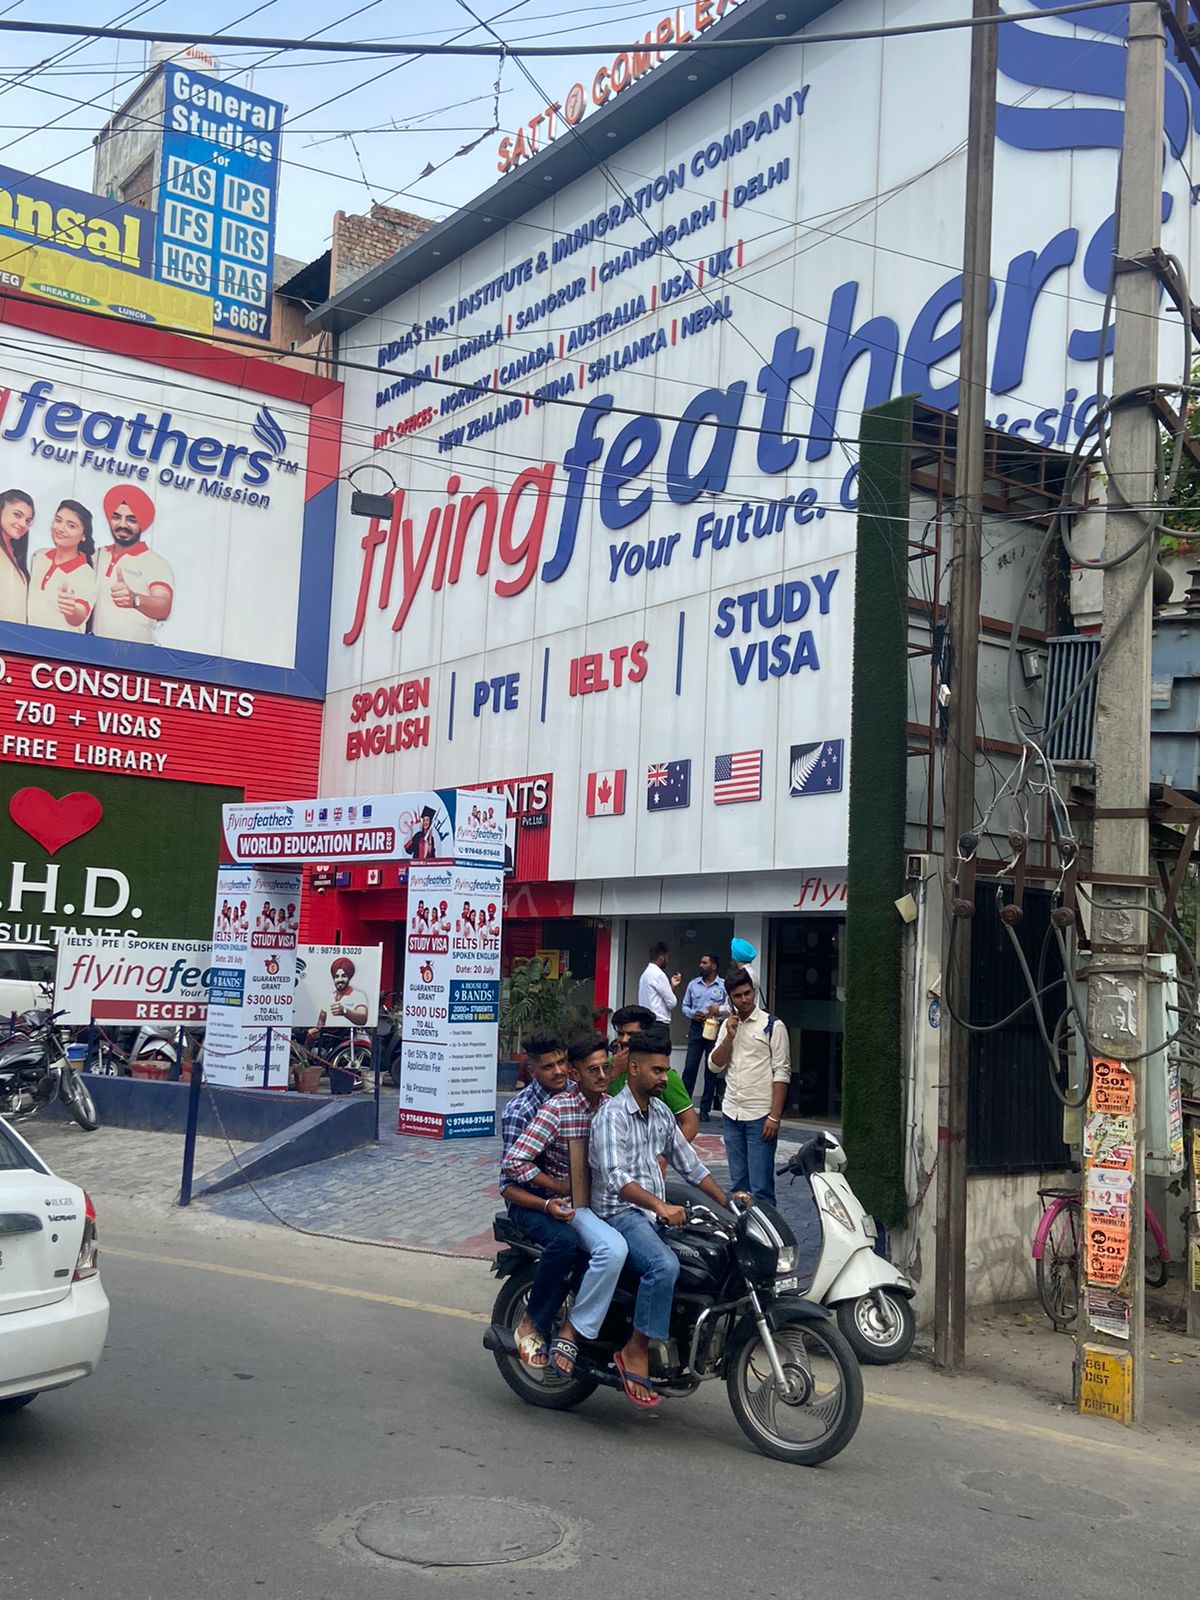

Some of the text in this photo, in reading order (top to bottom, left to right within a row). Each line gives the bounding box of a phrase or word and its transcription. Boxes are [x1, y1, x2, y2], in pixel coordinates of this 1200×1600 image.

[173, 71, 276, 131] General
[172, 105, 272, 163] Studies
[213, 151, 229, 168] for
[173, 161, 265, 218] IAS IPS
[457, 258, 533, 321] INSTITUTE
[535, 252, 548, 274] &
[552, 163, 685, 265] IMMIGRATION
[691, 84, 810, 177] COMPANY
[170, 205, 264, 262] IFS IRS
[166, 249, 263, 305] HCS RAS
[376, 158, 790, 408] BATHINDA BARNALA SANGRUR CHANDIGARH DELHI
[40, 283, 91, 305] BREAK FAST
[118, 306, 147, 321] LUNCH
[440, 374, 491, 416] NORWAY
[499, 342, 555, 385] CANADA
[567, 295, 646, 352] AUSTRALIA
[661, 269, 694, 302] USA
[708, 247, 733, 278] UK
[438, 296, 733, 453] NEW ZEALAND CHINA SRI LANKA NEPAL
[30, 437, 271, 508] Your Future Our Mission
[609, 533, 681, 582] Your
[693, 487, 825, 558] Future.
[714, 569, 840, 639] STUDY
[730, 630, 820, 686] VISA
[30, 662, 255, 718] CONSULTANTS
[350, 640, 648, 723] SPOKEN PTE IELTS
[15, 699, 162, 739] 750 + VISAS
[346, 716, 430, 761] ENGLISH
[2, 735, 168, 773] FREE LIBRARY
[227, 811, 293, 831] flyingfeathers
[240, 833, 385, 855] WORLD EDUCATION FAIR
[67, 937, 213, 953] IELTS PTE SPOKEN ENGLISH
[215, 931, 248, 943] IELTS PTE
[252, 934, 295, 948] STUDY VISA
[409, 937, 448, 951] STUDY VISA
[452, 937, 500, 951] IELTS PTE
[308, 946, 362, 955] M 98759 83020
[452, 951, 499, 960] SPOKEN ENGLISH
[252, 975, 290, 984] GUARANTEED
[455, 965, 494, 976] Date: 20 July
[180, 988, 201, 998] Your
[261, 983, 281, 991] GRANT
[409, 984, 445, 993] GUARANTEED
[454, 989, 495, 1001] 9 BANDS!
[247, 994, 271, 1005] $300
[274, 994, 293, 1005] USD
[417, 993, 436, 1001] GRANT
[254, 1014, 284, 1022] STUDENTS
[405, 1005, 447, 1019] $300 USD
[411, 1028, 439, 1038] STUDENTS
[416, 1020, 434, 1029] TO ALL
